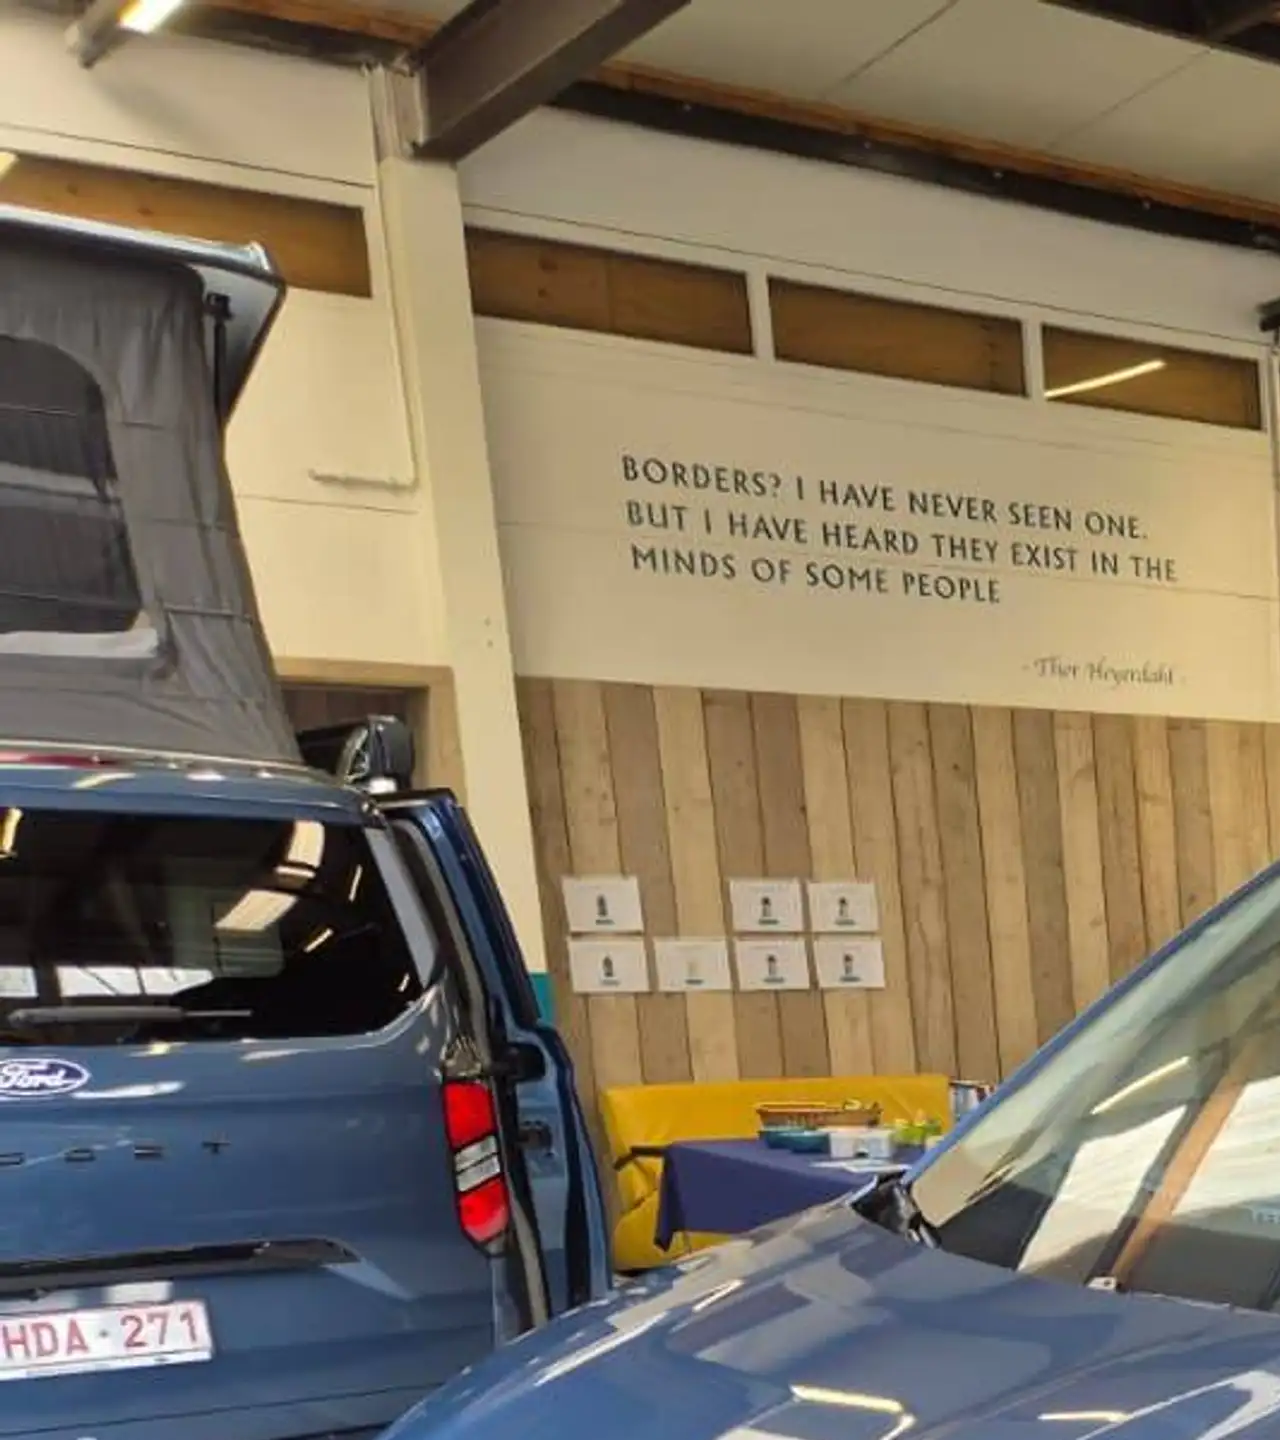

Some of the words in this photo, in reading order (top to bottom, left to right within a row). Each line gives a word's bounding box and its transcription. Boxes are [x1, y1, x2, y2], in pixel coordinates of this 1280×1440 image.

[621, 455, 782, 498] BORDERS?
[796, 475, 804, 500] I
[819, 479, 896, 512] HAVE
[907, 490, 998, 524] NEVER
[1008, 502, 1073, 532] SEEN
[1084, 511, 1149, 540] ONE.
[626, 499, 690, 532] BUT
[703, 508, 712, 534] I
[728, 511, 808, 544] HAVE
[822, 521, 919, 556] HEARD
[931, 533, 999, 563] THEY
[1011, 542, 1078, 572] EXIST
[1091, 550, 1119, 576] IN
[1130, 555, 1178, 582] THE
[630, 543, 736, 580] MINDS
[751, 557, 792, 585] OF
[805, 562, 889, 594] SOME
[902, 572, 1001, 604] PEOPLE
